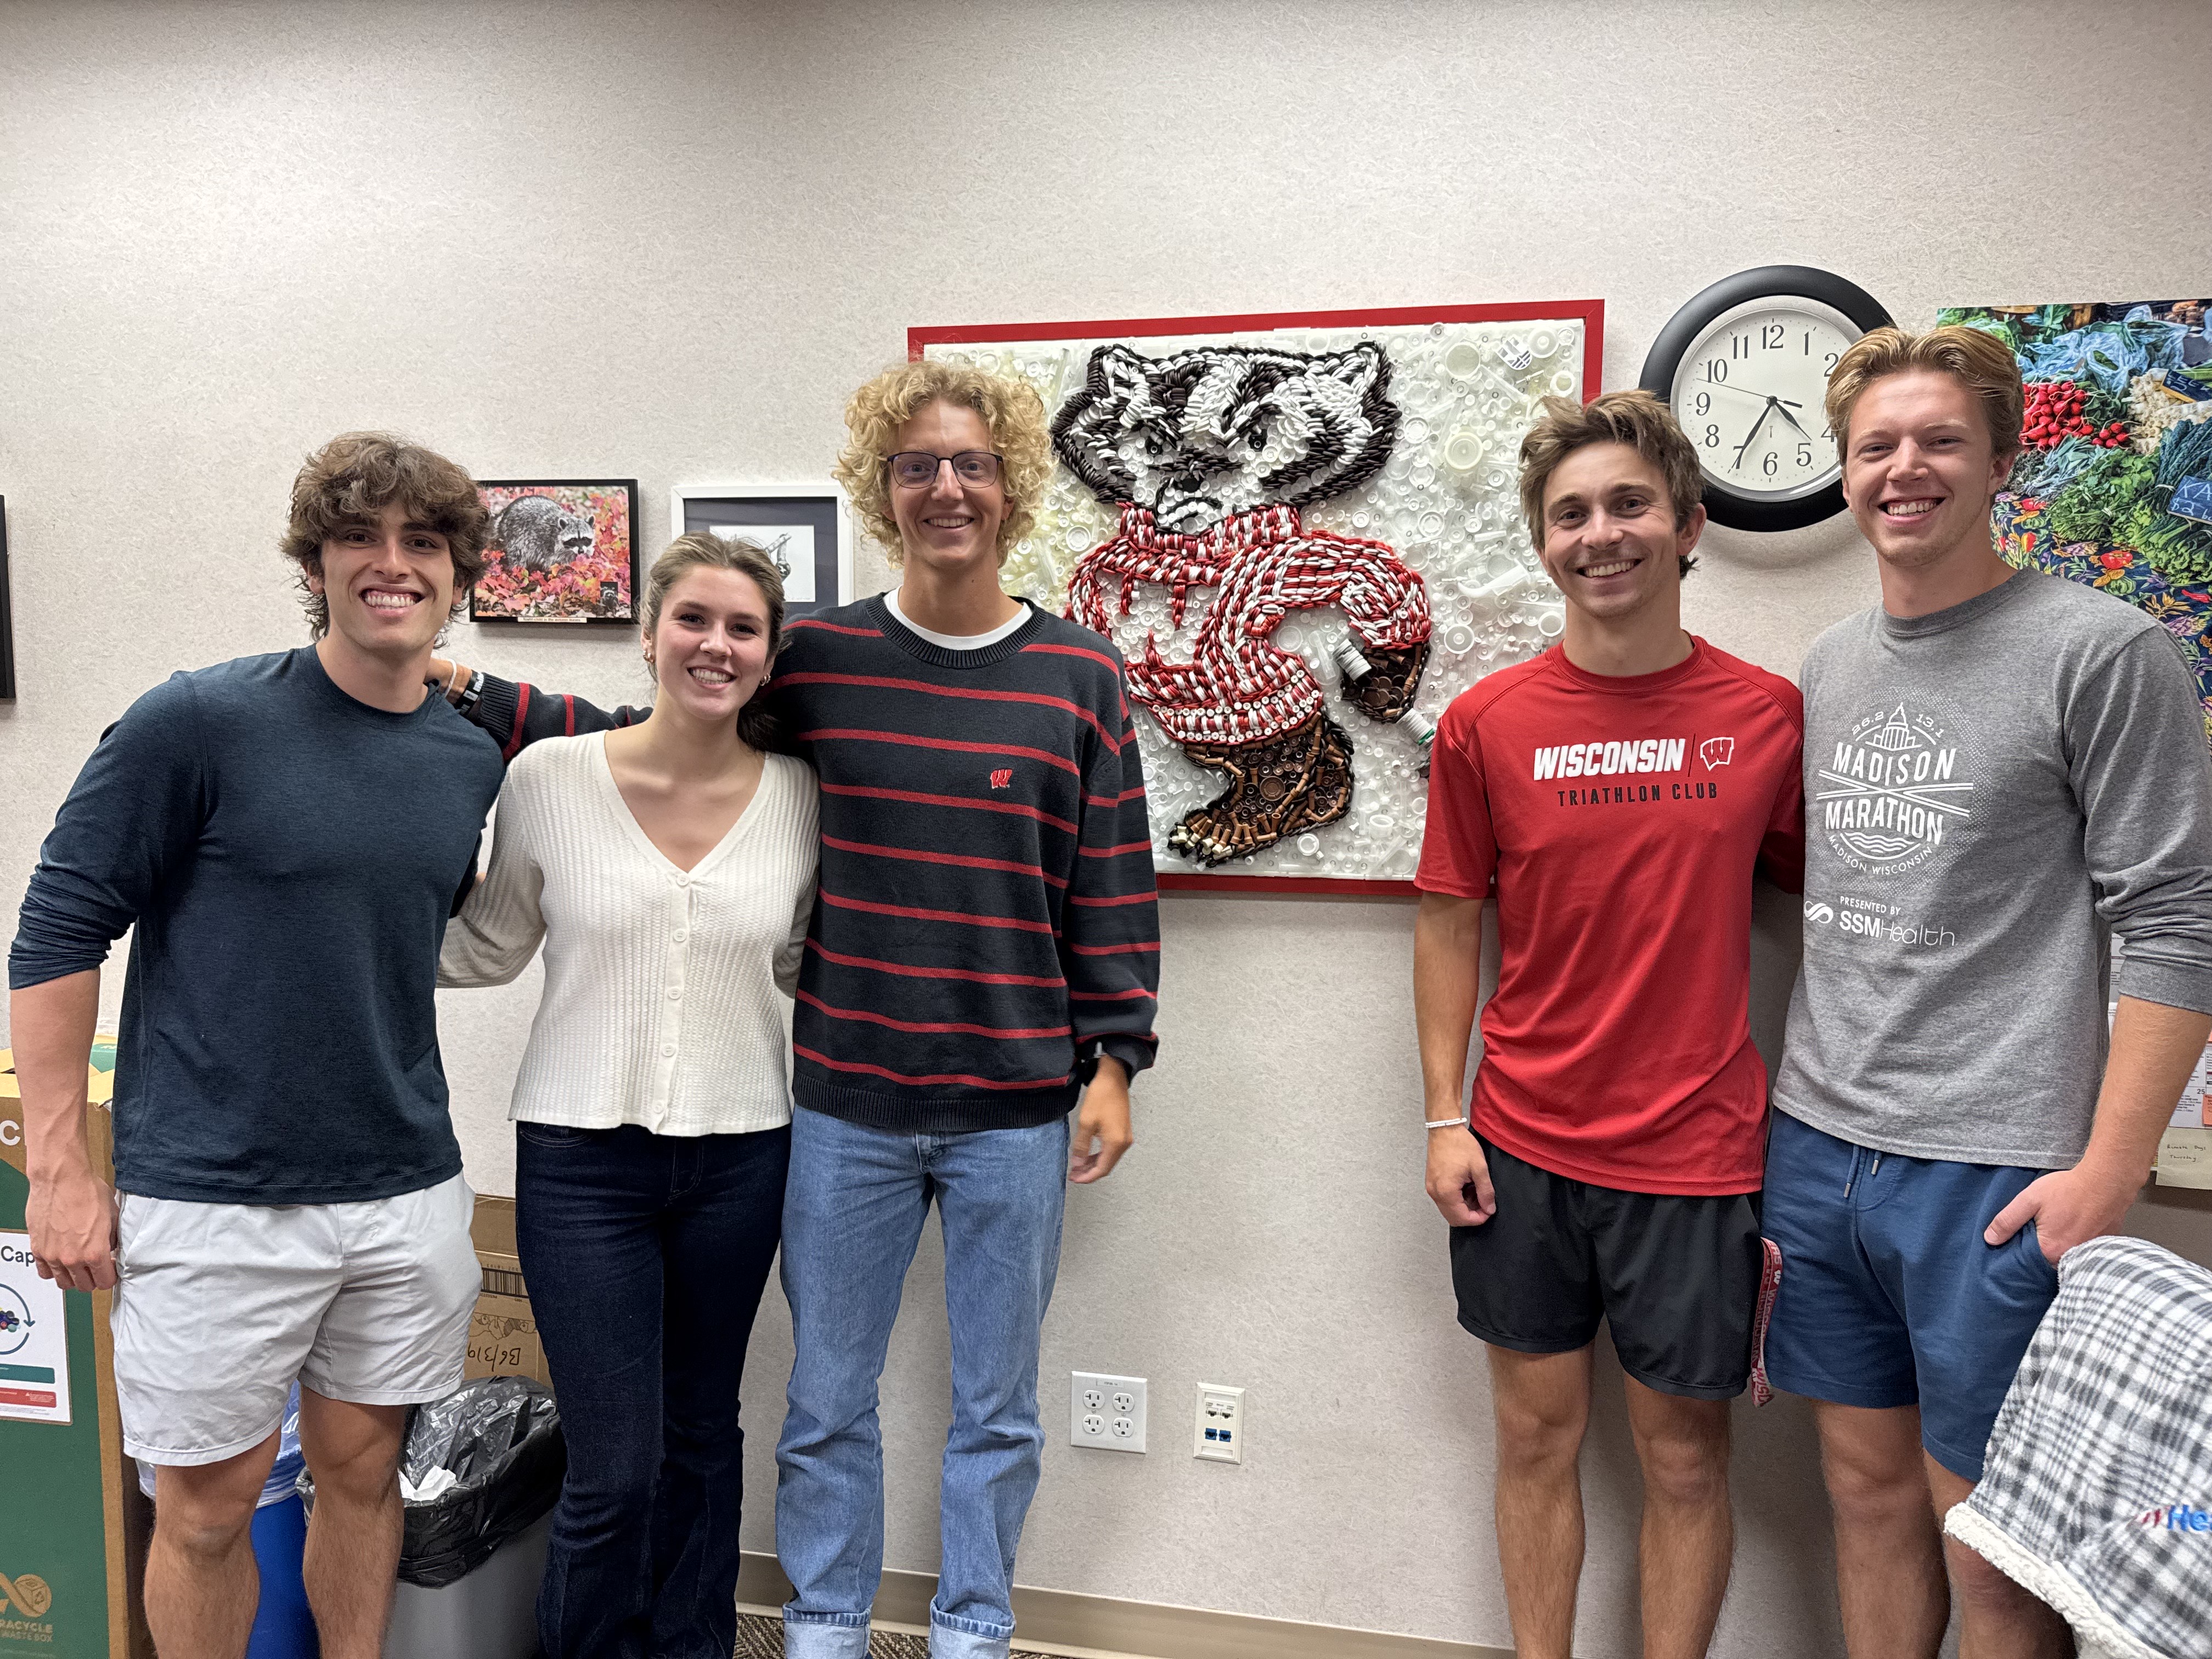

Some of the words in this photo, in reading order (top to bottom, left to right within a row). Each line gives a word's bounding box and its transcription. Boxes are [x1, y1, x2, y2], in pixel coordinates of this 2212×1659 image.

[1733, 335, 1748, 359] 11
[1762, 325, 1784, 349] 12
[1804, 332, 1809, 356] 1
[1707, 359, 1728, 383] 10
[1824, 353, 1839, 377] 2
[1696, 392, 1711, 416] 9
[1705, 425, 1720, 448] 8
[1820, 427, 1836, 443] 4
[1733, 445, 1744, 470] 7
[1763, 452, 1778, 476] 6
[1796, 443, 1812, 467] 5
[1852, 711, 1884, 735] 26.2
[1915, 714, 1944, 738] 13.1
[1533, 738, 1685, 781] WISCONSIN
[1832, 742, 1956, 786] MADISON
[1558, 785, 1660, 806] TRIATHLON
[1672, 782, 1717, 800] CLUB
[1825, 797, 1943, 845] MARATHON
[1828, 834, 1867, 873] MADISON
[1872, 846, 1932, 875] WISCONSIN
[1839, 895, 1887, 913] PRESENTED
[1890, 905, 1901, 916] BY
[1839, 910, 1955, 946] SSMHealth
[2166, 1504, 2212, 1532] He
[33, 1633, 53, 1643] BOX
